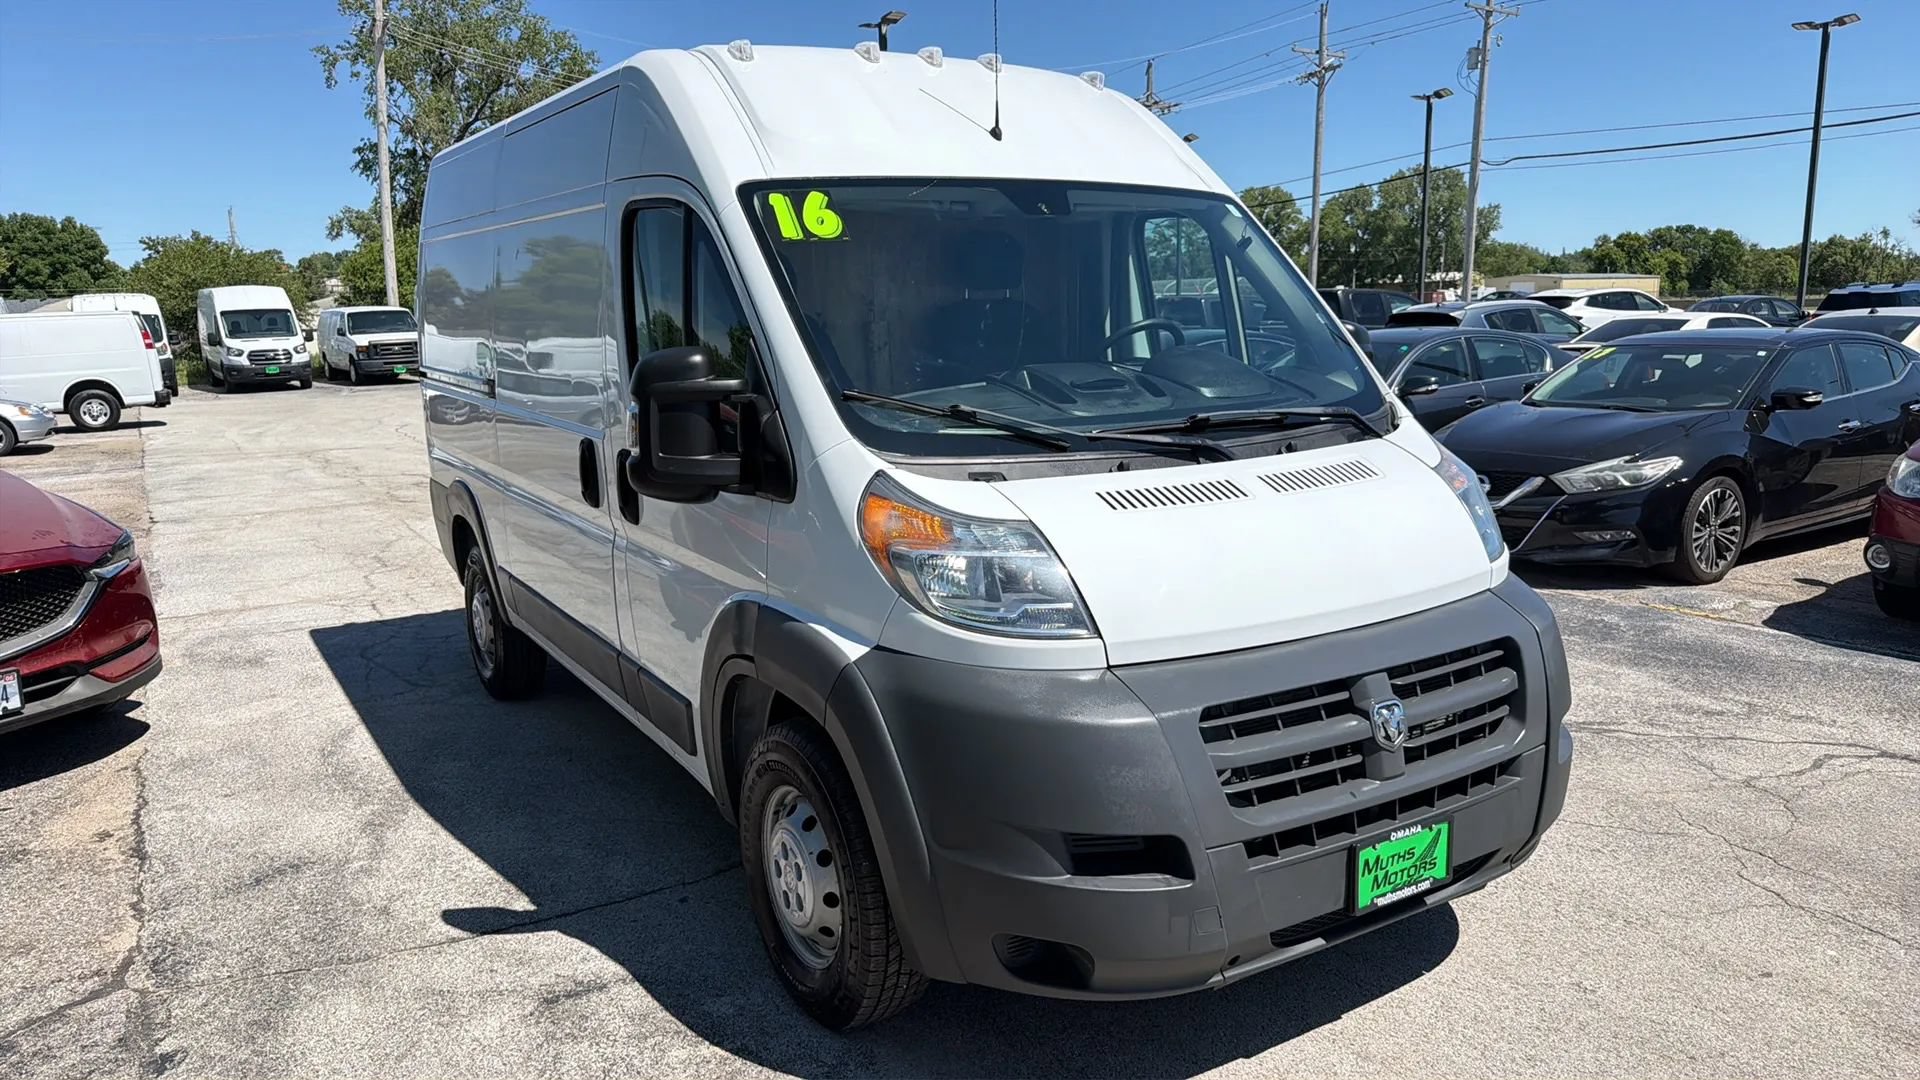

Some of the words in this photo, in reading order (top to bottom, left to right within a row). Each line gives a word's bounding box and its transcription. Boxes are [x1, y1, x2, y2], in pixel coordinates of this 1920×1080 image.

[768, 190, 843, 240] 16
[1390, 824, 1422, 841] OMAHA
[1370, 857, 1438, 892] MOTORS
